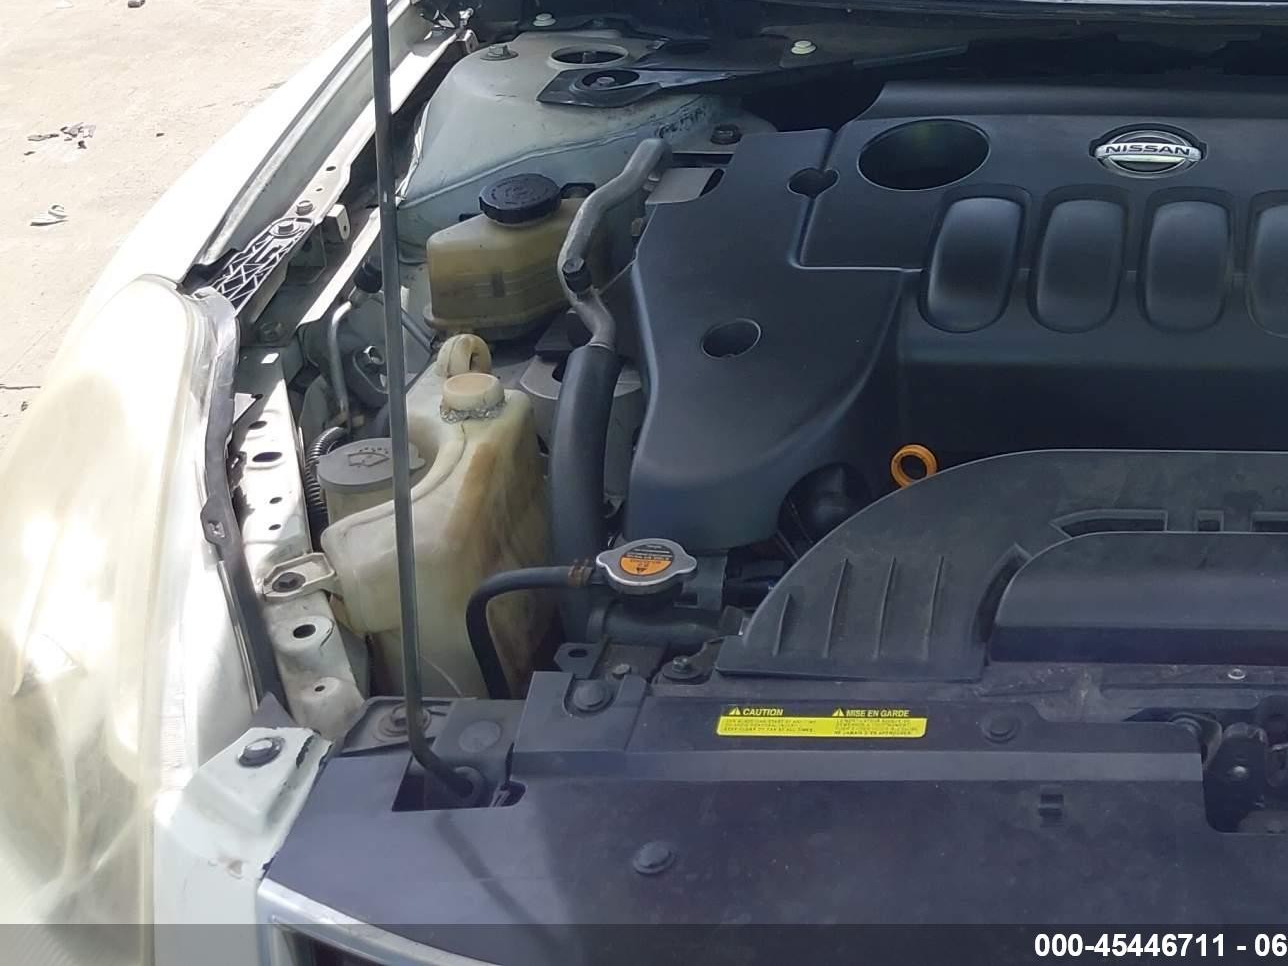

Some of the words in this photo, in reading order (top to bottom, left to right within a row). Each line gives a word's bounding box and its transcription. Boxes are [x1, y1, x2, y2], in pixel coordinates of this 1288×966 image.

[1105, 144, 1191, 156] NISSAN
[742, 707, 784, 716] CAUTION
[846, 709, 866, 717] MISE
[867, 709, 880, 717] EN
[880, 709, 910, 717] GARDE
